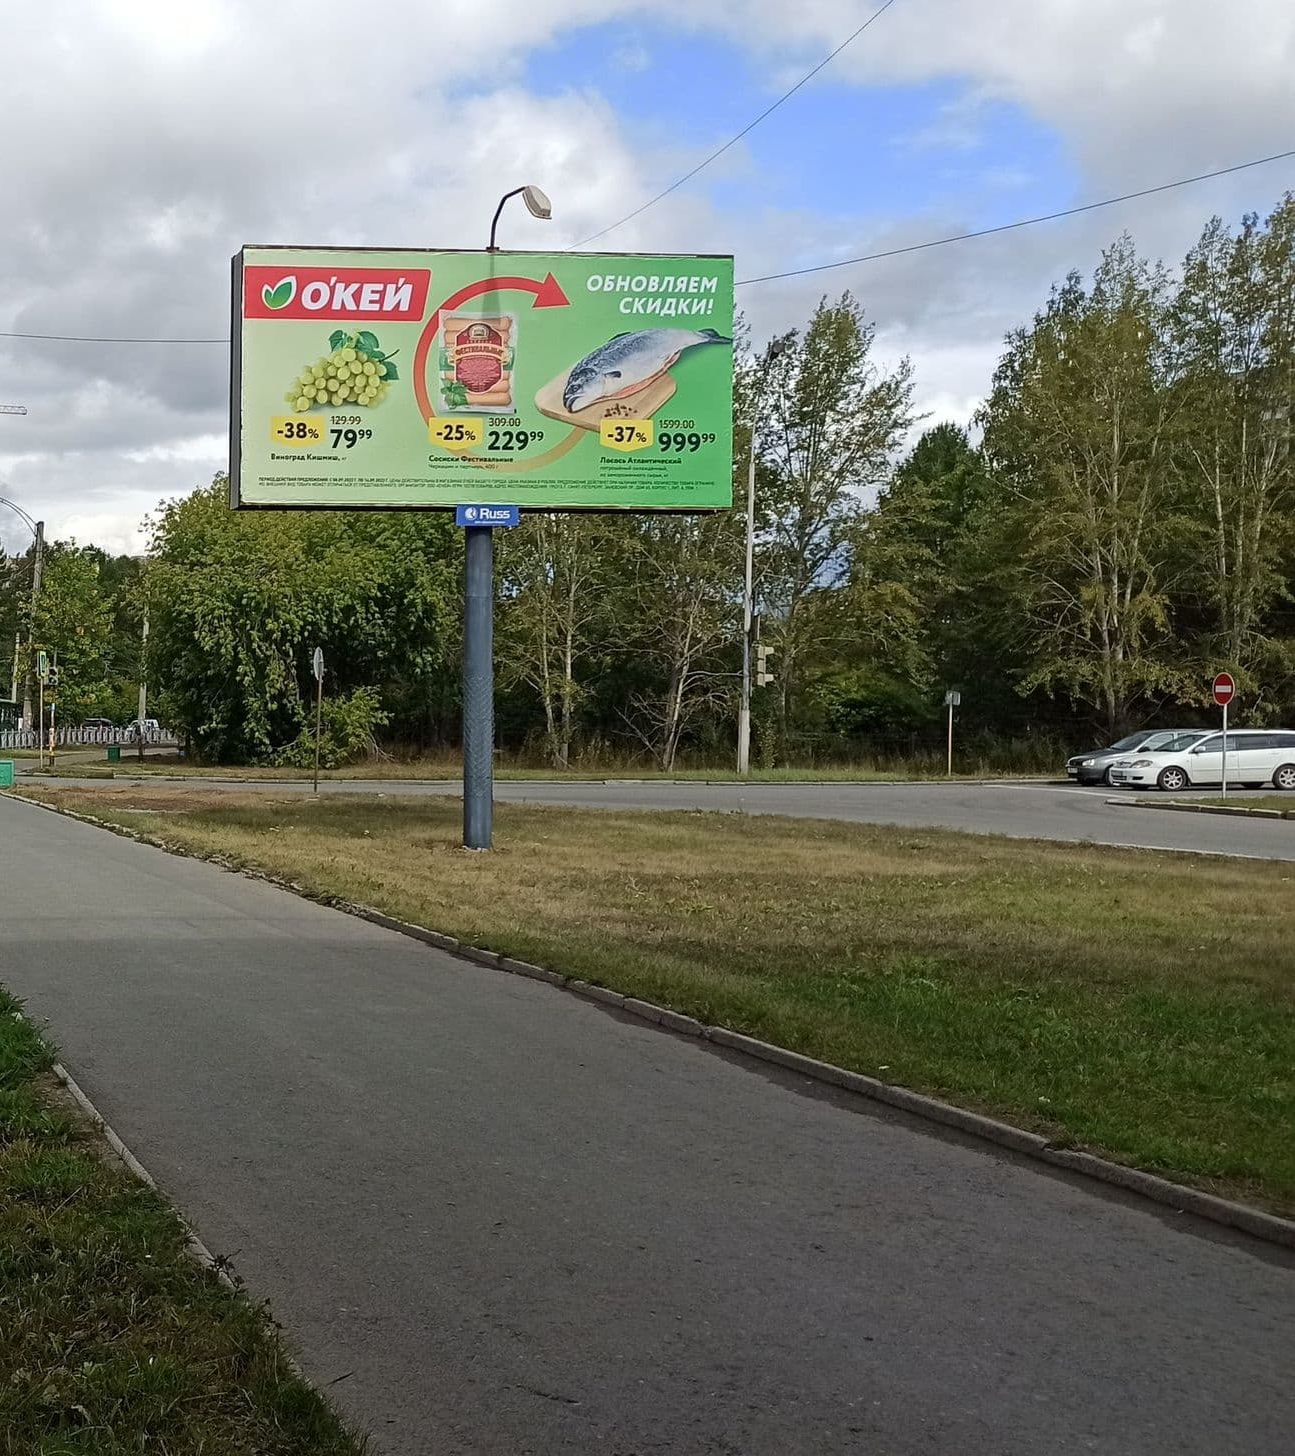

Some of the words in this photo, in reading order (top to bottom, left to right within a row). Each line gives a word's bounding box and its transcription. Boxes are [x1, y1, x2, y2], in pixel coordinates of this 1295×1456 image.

[586, 274, 718, 293] ОБНОВЛЯЕМ
[619, 297, 714, 317] СКИДКИ!
[277, 422, 319, 439] -38%
[436, 425, 476, 441] -25%
[607, 426, 647, 442] -37%
[479, 508, 511, 519] Russ
